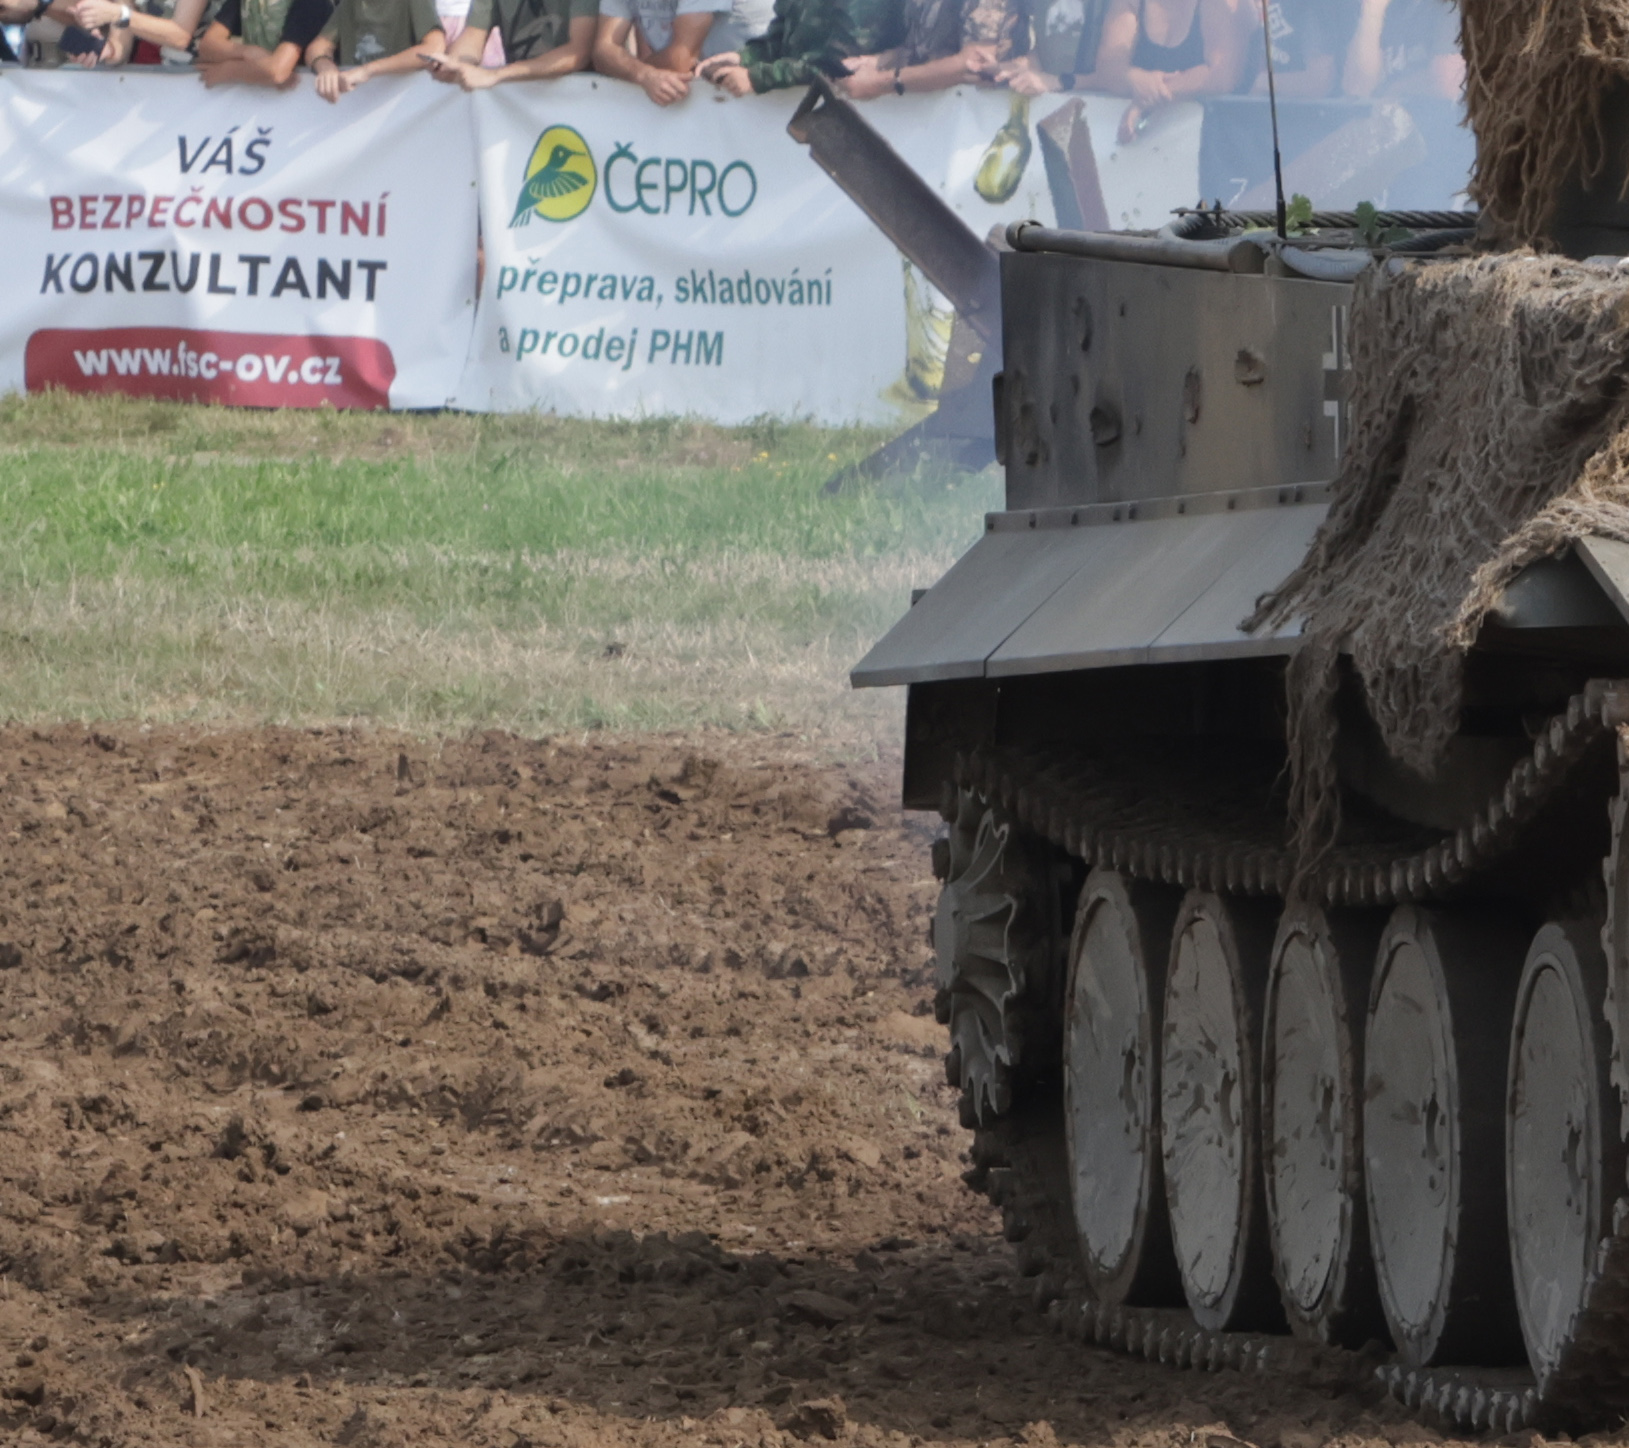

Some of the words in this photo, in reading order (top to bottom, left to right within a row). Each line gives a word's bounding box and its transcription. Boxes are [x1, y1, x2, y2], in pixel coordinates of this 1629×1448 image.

[176, 125, 271, 177] VÁŠ
[604, 141, 757, 219] ČEPRO
[50, 186, 388, 238] BEZPEČNOSTNÍ
[40, 252, 388, 302] KONZULTANT
[497, 261, 663, 308] přeprava,
[674, 266, 833, 308] skladování
[74, 343, 342, 386] www.fsc-ov.cz
[498, 326, 511, 355] a
[517, 322, 636, 367] prodej
[648, 330, 724, 367] PHM
